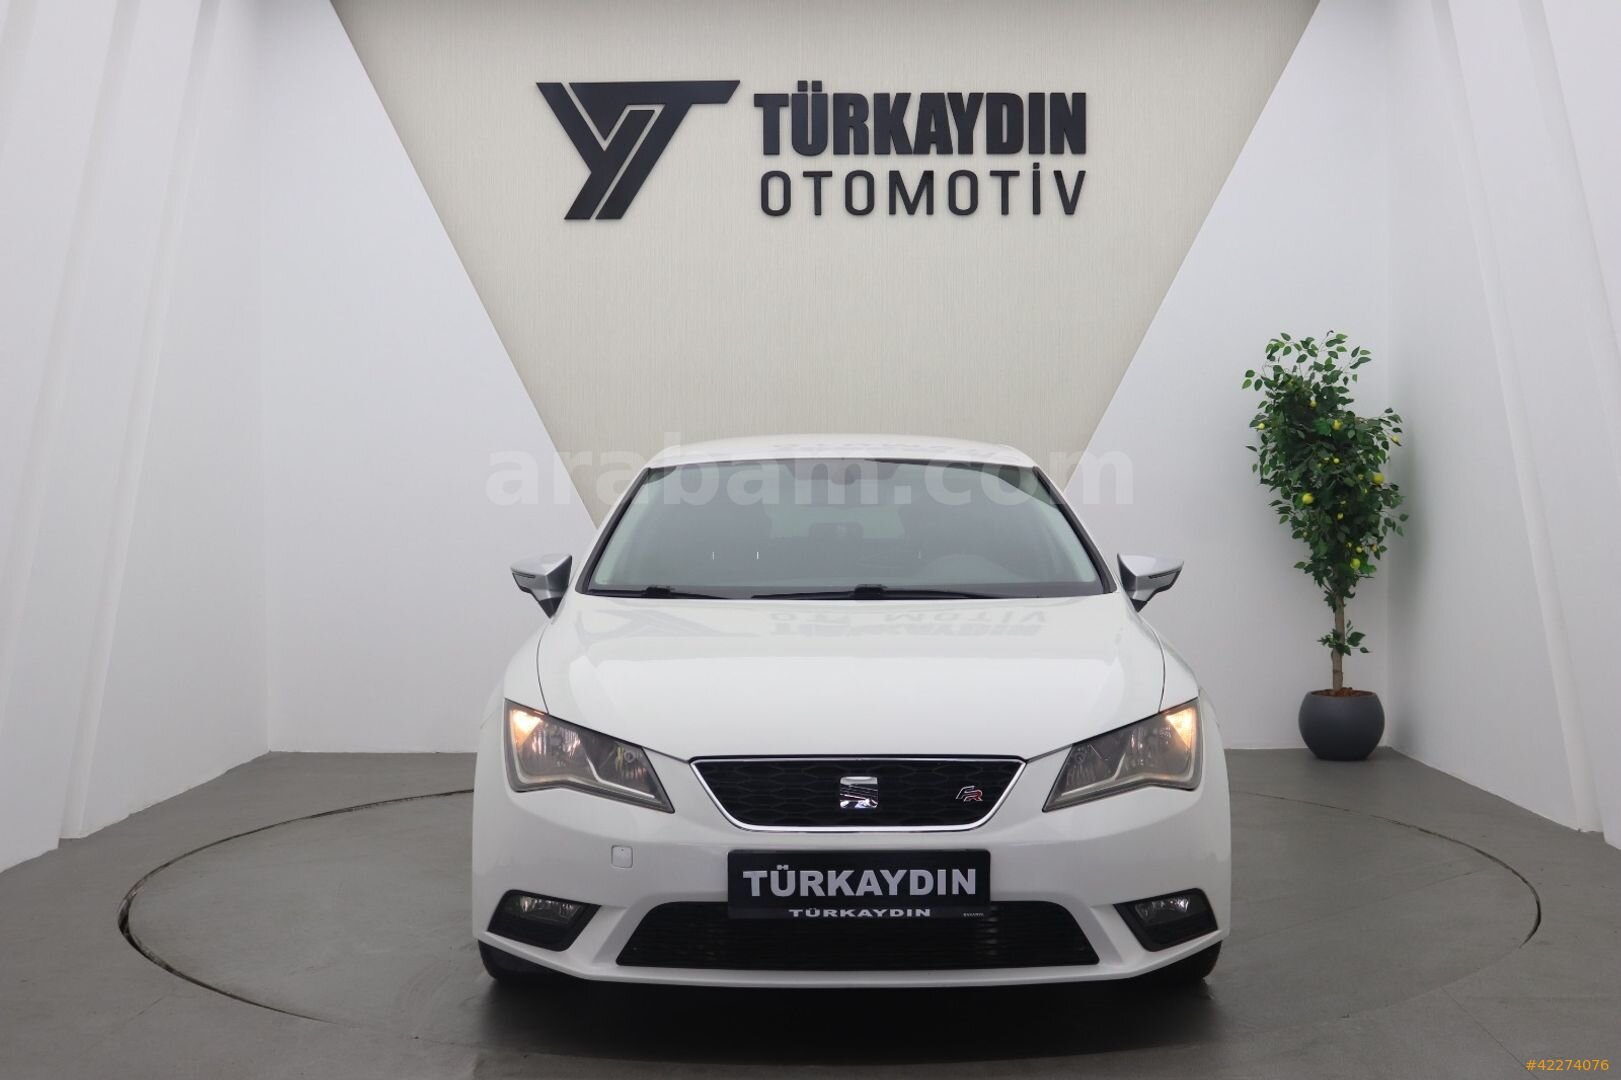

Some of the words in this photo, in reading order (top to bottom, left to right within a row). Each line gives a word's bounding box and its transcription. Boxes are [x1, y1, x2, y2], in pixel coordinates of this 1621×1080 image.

[753, 80, 1087, 156] TÜRKAYDIN
[760, 162, 1087, 217] OTOMOTİV
[743, 864, 976, 897] TÜRKAYDIN
[788, 907, 931, 918] TÜRKAYDIN
